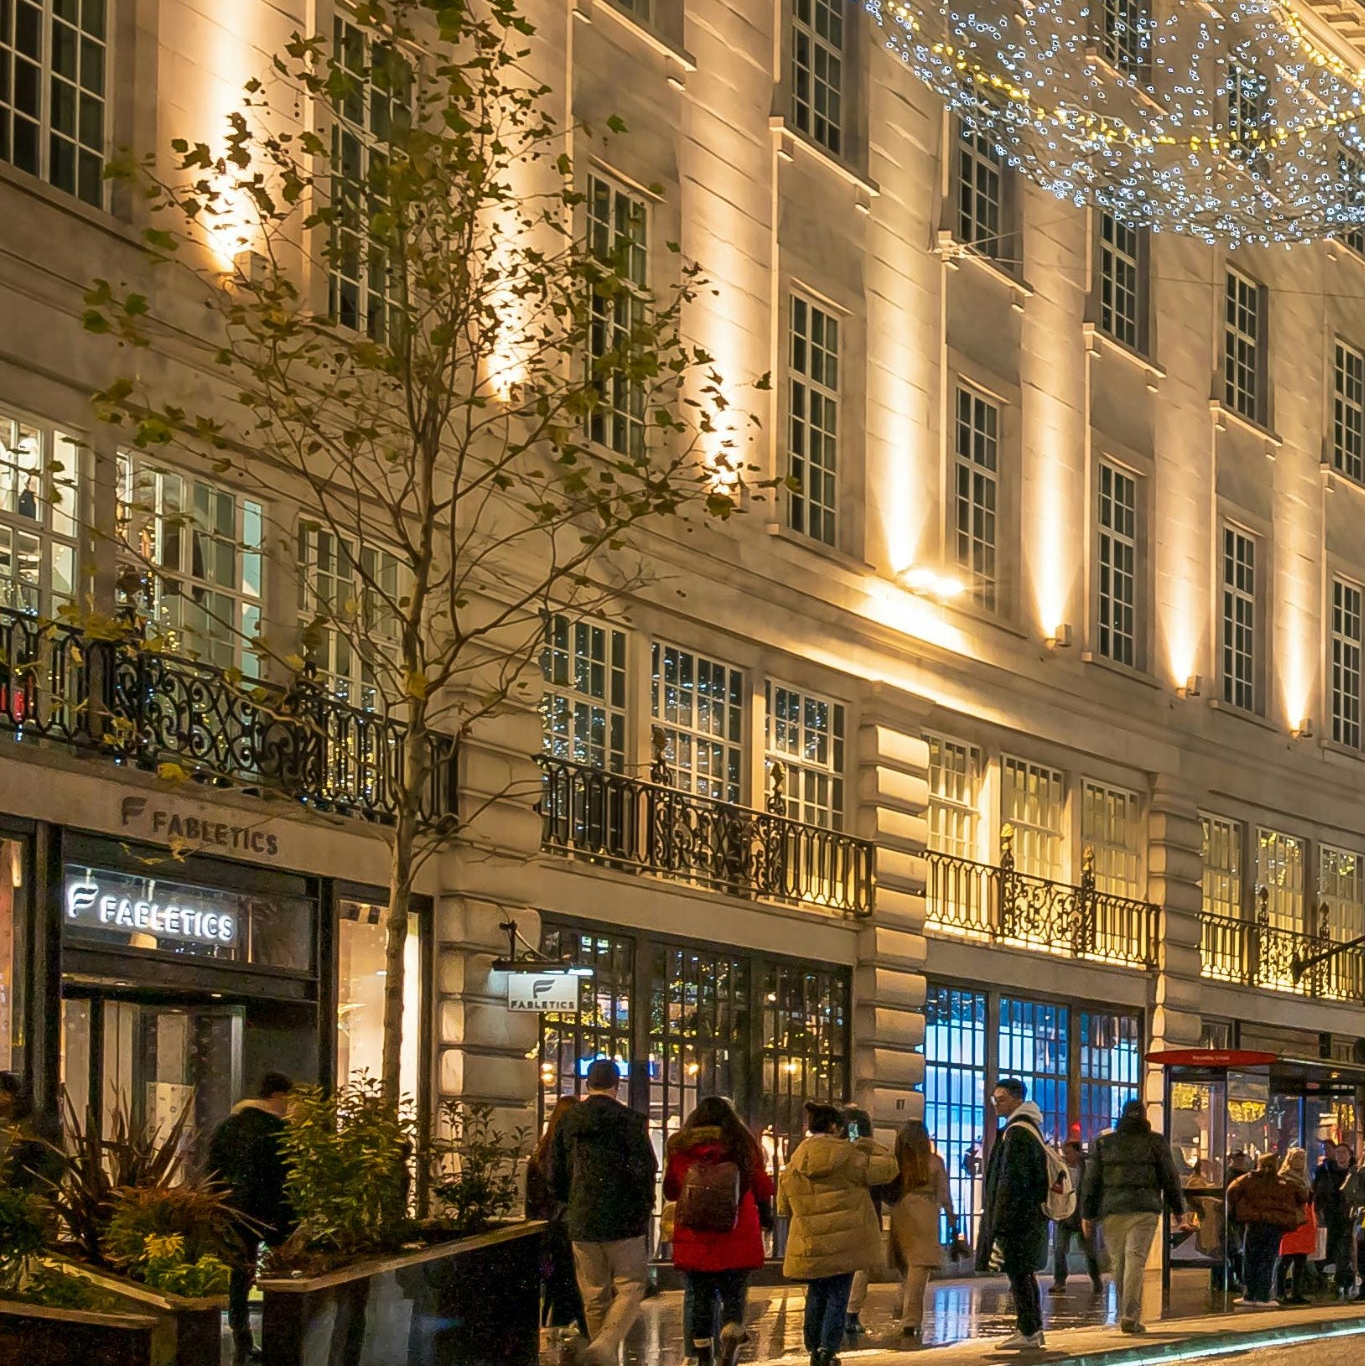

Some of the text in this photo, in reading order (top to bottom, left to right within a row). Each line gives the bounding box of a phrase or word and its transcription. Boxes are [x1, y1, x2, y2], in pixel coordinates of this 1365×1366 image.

[154, 812, 278, 856] FABLETICS
[100, 895, 233, 942] FABLETICS
[510, 1000, 575, 1010] FABLETICS
